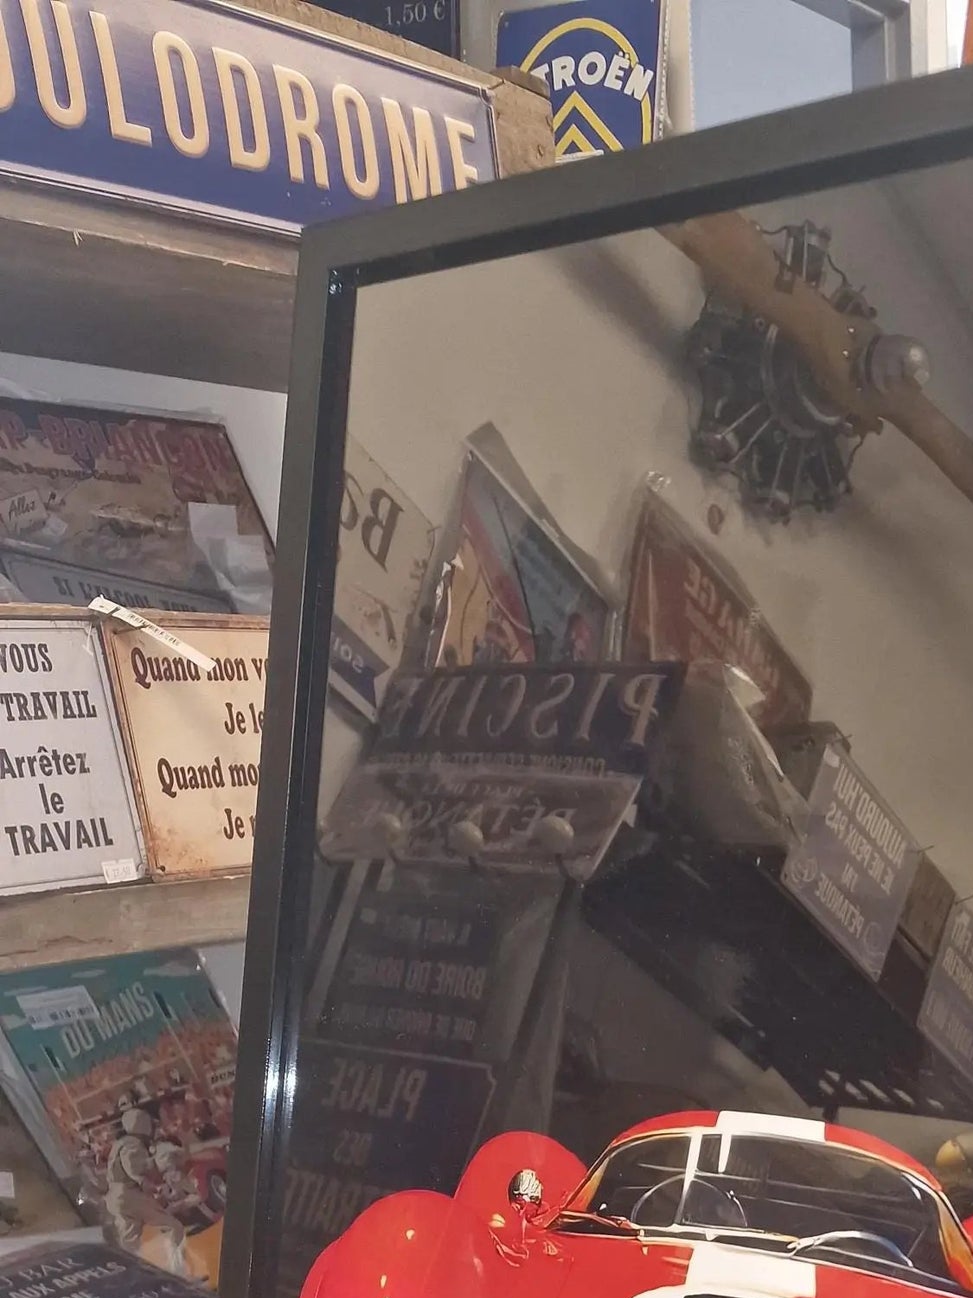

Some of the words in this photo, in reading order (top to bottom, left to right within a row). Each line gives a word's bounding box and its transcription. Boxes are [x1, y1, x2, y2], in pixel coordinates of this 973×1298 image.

[530, 50, 654, 101] TROËN
[130, 646, 200, 689] Quand
[206, 657, 249, 682] mon
[1, 690, 97, 722] TRAVAIL
[224, 702, 247, 735] Je
[0, 746, 90, 780] Arrêtez
[157, 756, 225, 799] Quand
[39, 783, 64, 815] le
[5, 817, 114, 857] TRAVAIL
[223, 808, 245, 840] Je
[93, 981, 154, 1042] MANS
[52, 1261, 127, 1289] APPELS
